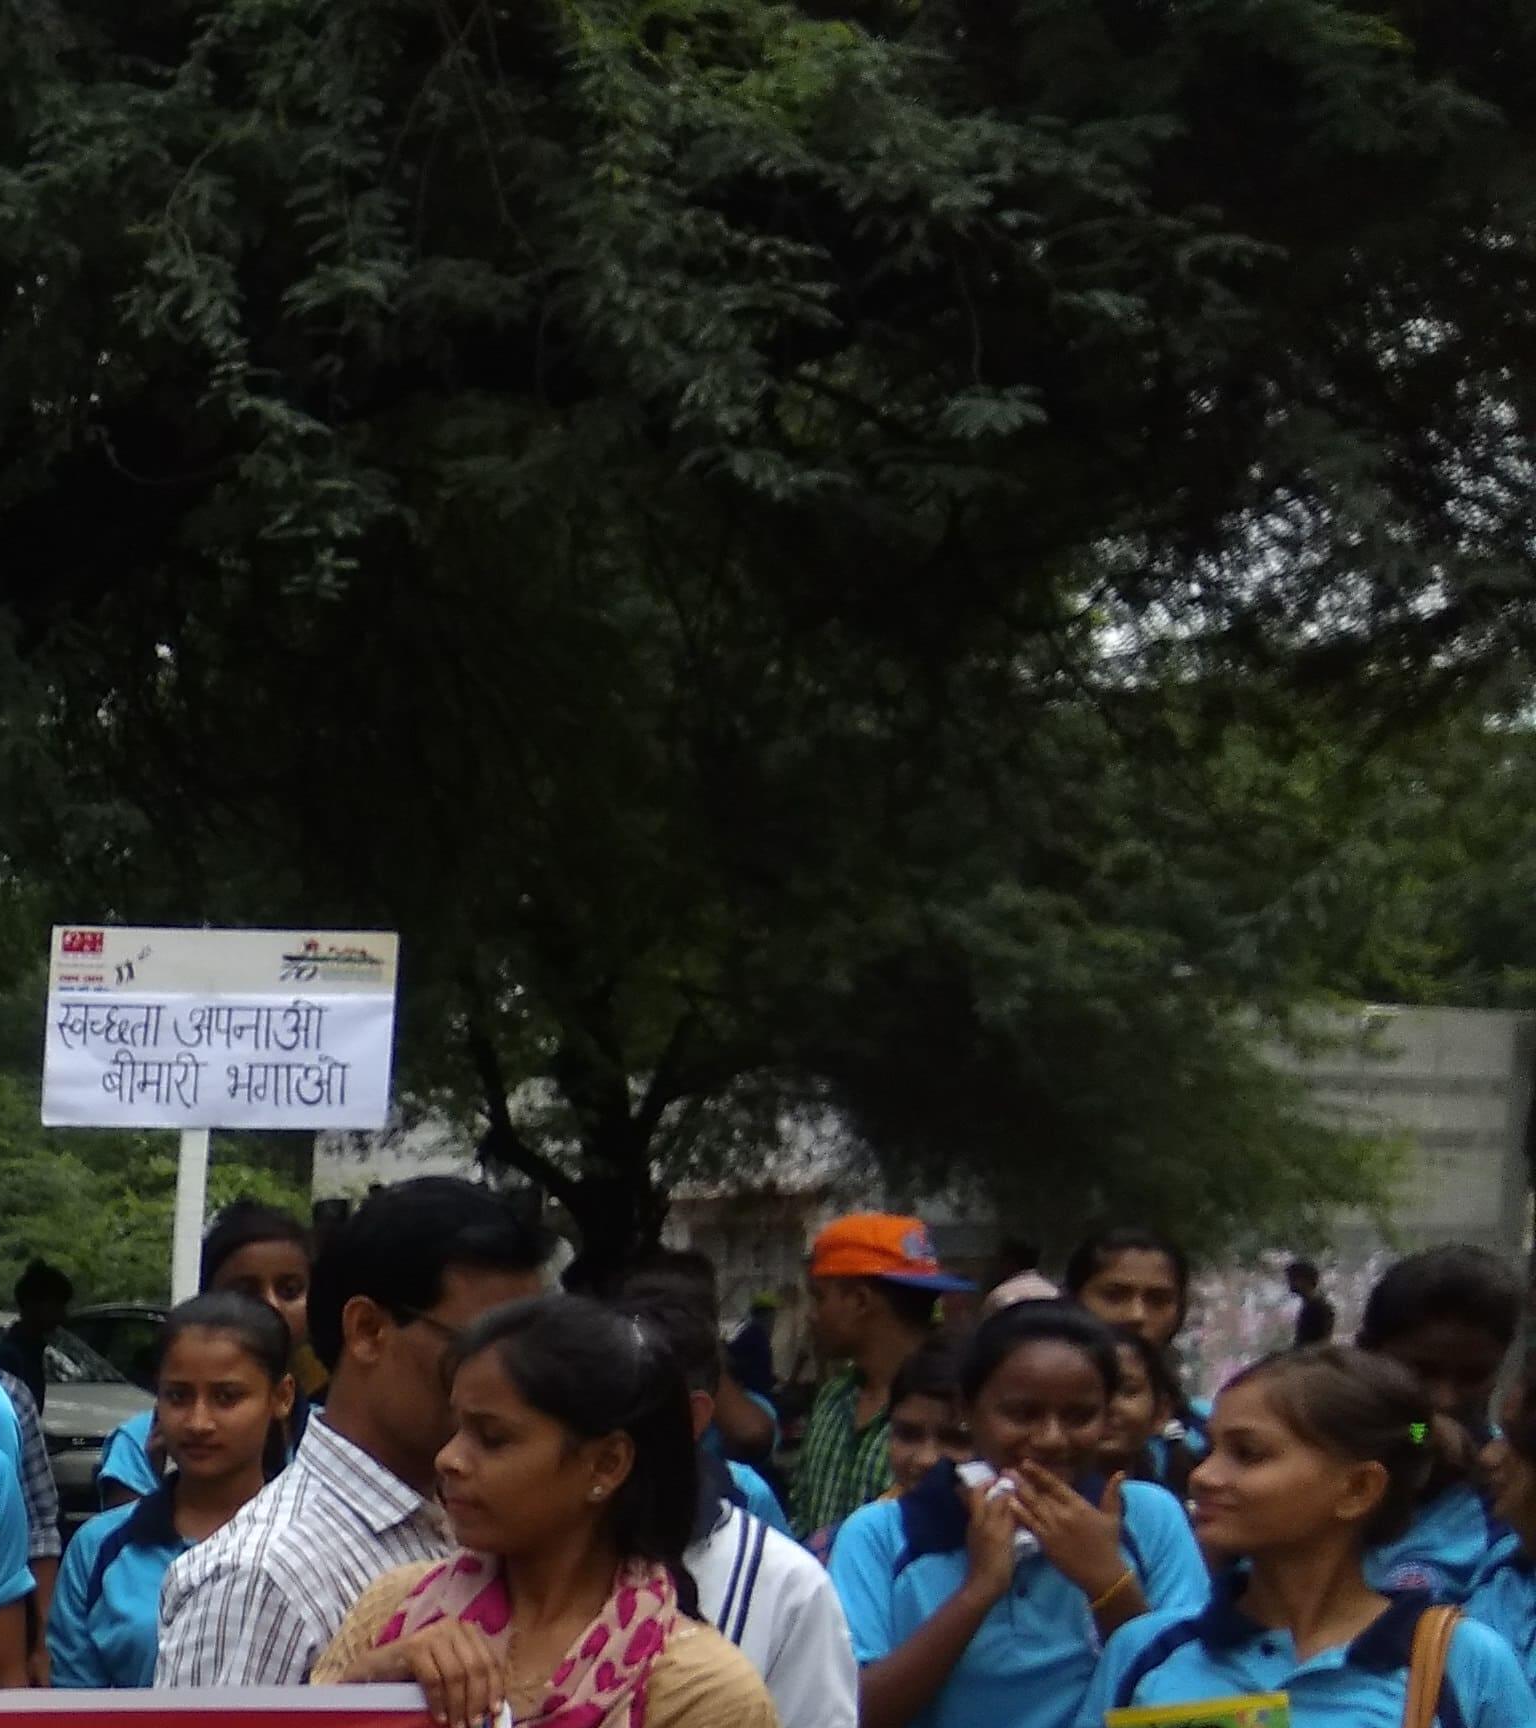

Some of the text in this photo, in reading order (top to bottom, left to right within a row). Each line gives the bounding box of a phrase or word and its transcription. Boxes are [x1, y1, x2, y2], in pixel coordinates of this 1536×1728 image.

[57, 1000, 330, 1051] स्वच्छता अपनाओ
[102, 1050, 351, 1108] बीमारी भगाओ
